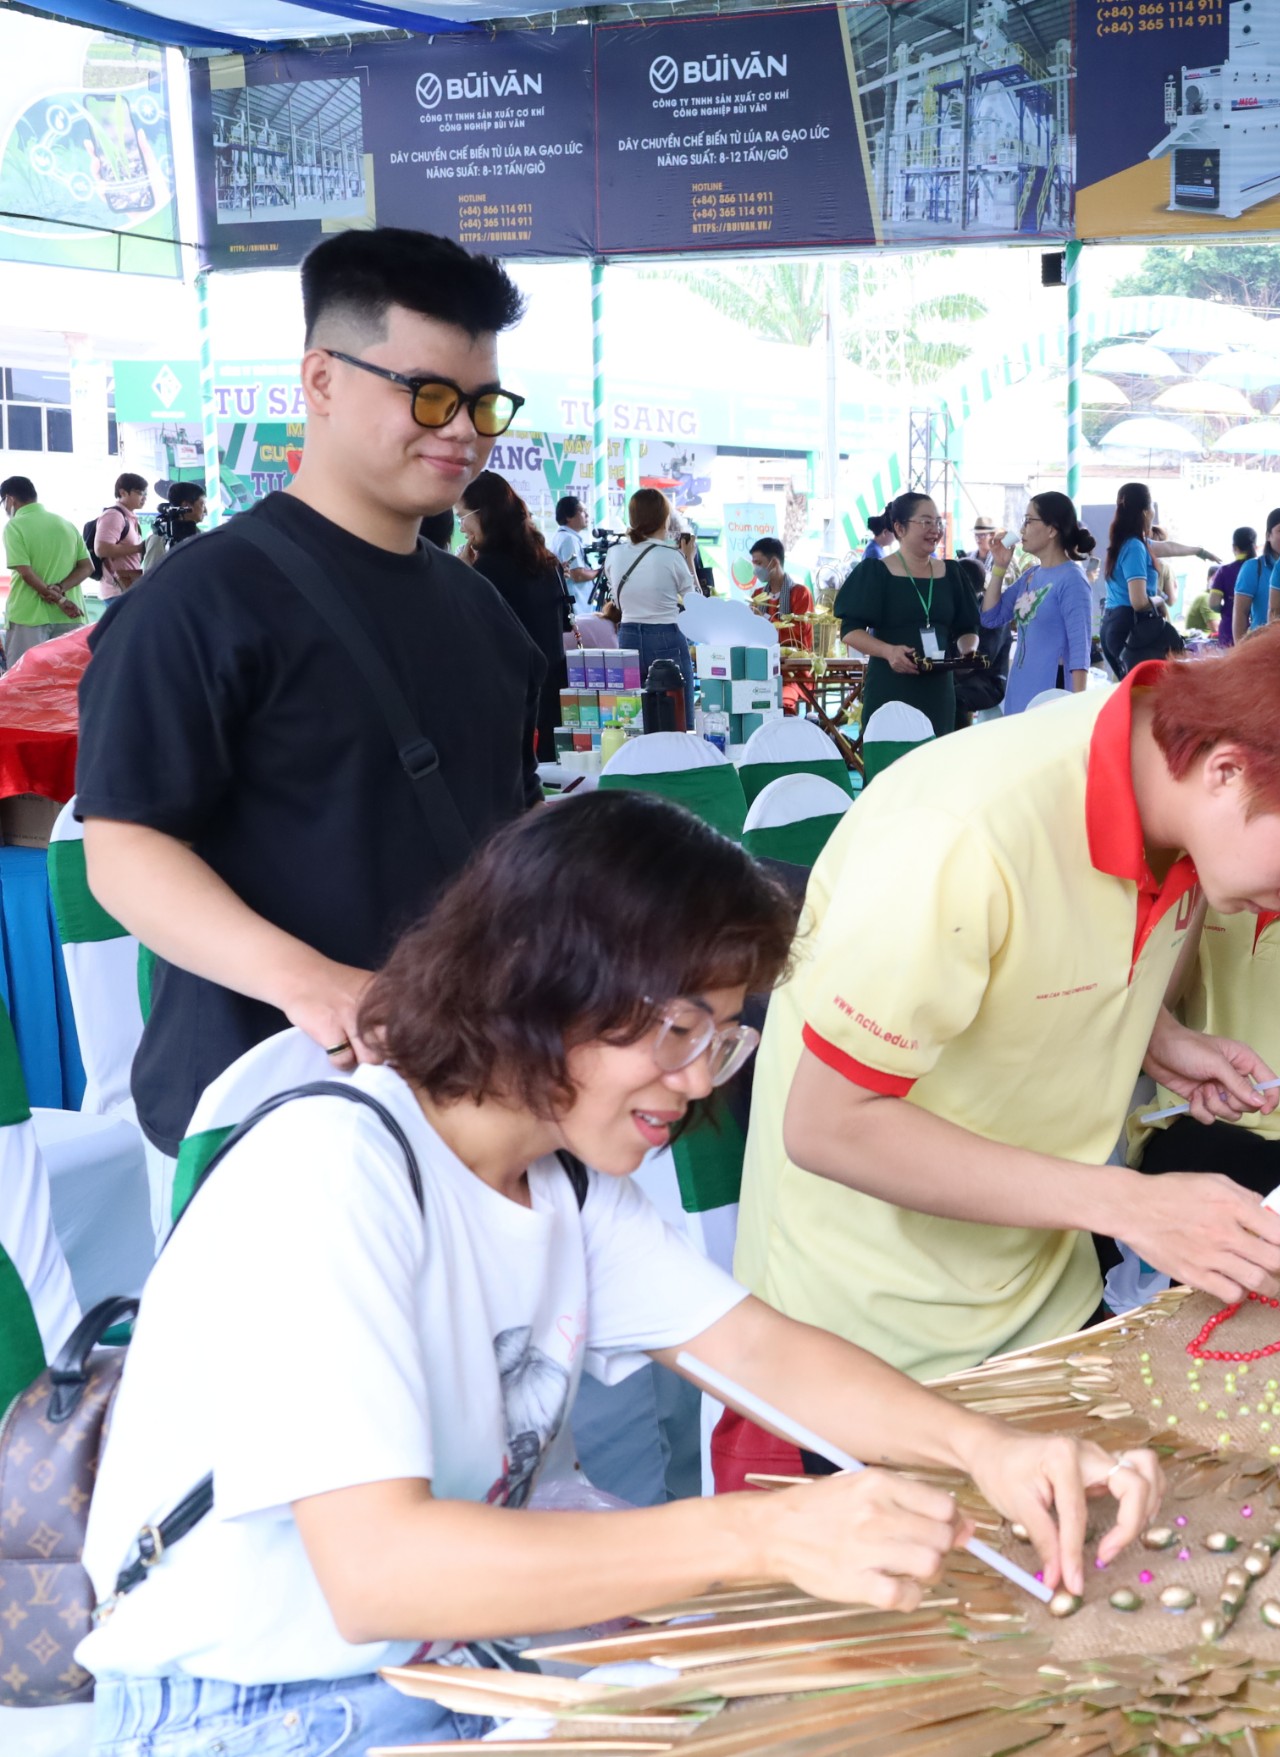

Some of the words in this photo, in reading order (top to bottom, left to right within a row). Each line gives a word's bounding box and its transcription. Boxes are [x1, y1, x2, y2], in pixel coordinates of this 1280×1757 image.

[1097, 6, 1134, 21] (+84)
[1138, 3, 1164, 16] 866
[1168, 1, 1194, 13] 114
[1198, 0, 1222, 10] 911
[1096, 21, 1134, 37] (+84)
[1138, 18, 1164, 31] 365
[1168, 16, 1194, 29] 114
[1198, 13, 1222, 27] 911
[618, 136, 639, 151] DÂY
[682, 131, 705, 147] CHẾ
[705, 129, 728, 146] BIẾN
[729, 129, 742, 145] TỪ
[743, 128, 762, 144] LÚA
[765, 130, 779, 143] RA
[781, 128, 808, 144] GẠO
[390, 150, 409, 164] DÂY
[449, 144, 468, 161] CHẾ
[469, 144, 490, 160] BIẾN
[491, 144, 502, 158] TỪ
[504, 144, 522, 158] LÚA
[524, 145, 536, 157] RA
[538, 143, 563, 158] GẠO
[657, 152, 689, 167] NĂNG
[690, 148, 717, 165] SUẤT:
[719, 151, 741, 163] 8-12
[743, 145, 789, 163] TẤN/GIỜ
[426, 166, 454, 179] NĂNG
[456, 162, 481, 178] SUẤT:
[482, 165, 503, 177] 8-12
[504, 159, 546, 176] TẤN/GIỜ
[692, 182, 723, 192] HOTLINE
[458, 193, 487, 203] HOTLINE
[692, 194, 717, 208] (+84)
[718, 193, 736, 204] 866
[738, 192, 755, 203] 114
[757, 191, 773, 202] 911
[459, 205, 481, 218] (+84)
[483, 205, 499, 215] 866
[500, 204, 516, 214] 114
[517, 203, 532, 213] 911
[692, 208, 717, 221] (+84)
[719, 206, 736, 217] 365
[738, 206, 755, 217] 114
[757, 205, 773, 215] 911
[459, 218, 481, 231] (+84)
[483, 217, 499, 228] 365
[501, 217, 516, 227] 114
[518, 216, 532, 226] 911
[614, 404, 697, 435] SANG
[488, 445, 542, 471] ANG
